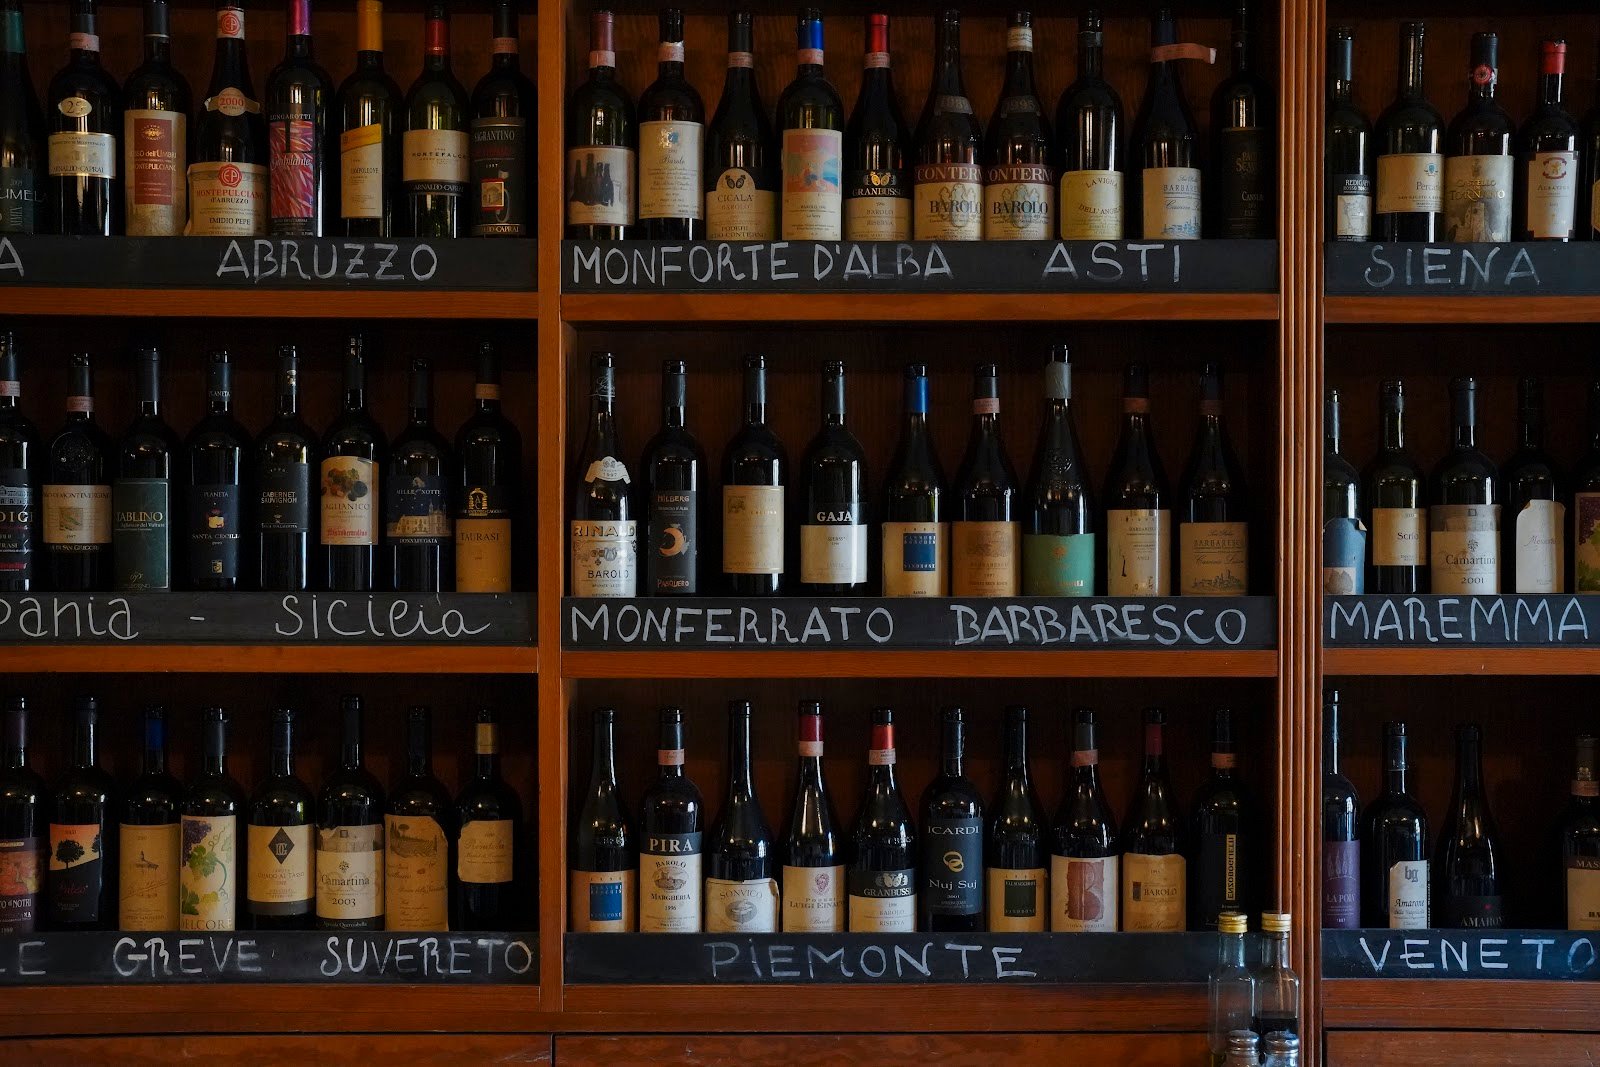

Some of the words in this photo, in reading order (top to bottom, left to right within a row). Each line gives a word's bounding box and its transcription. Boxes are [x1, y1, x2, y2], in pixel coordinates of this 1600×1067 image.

[220, 98, 244, 106] 2000
[930, 200, 982, 213] BAROLO
[993, 200, 1048, 214] BAROLO
[216, 239, 438, 284] ABRUZZO
[573, 243, 799, 286] MONFORTE
[813, 243, 954, 281] D'ALBA
[1042, 242, 1181, 283] ASTI
[1364, 245, 1541, 288] SIENA
[816, 511, 852, 522] GAJA
[1445, 554, 1496, 565] Camartina
[571, 604, 893, 643] MONFERRATO
[950, 604, 1247, 645] BARBARESCO
[1329, 598, 1589, 642] MAREMMA
[927, 825, 980, 835] ICARDI
[649, 838, 693, 852] PIRA
[655, 860, 687, 868] BAROLO
[321, 874, 370, 886] Camartina
[1404, 865, 1419, 883] bg
[928, 879, 953, 891] Nuj
[957, 879, 977, 889] Suj
[1143, 887, 1177, 896] BAROLO
[331, 897, 356, 906] 2003
[651, 893, 691, 901] MARGHERIA
[1394, 899, 1425, 908] Amarone
[790, 901, 815, 909] LUIGI
[113, 936, 262, 978] GREVE
[320, 936, 533, 977] SUVERETO
[703, 938, 1037, 979] PIEMONTE
[1359, 937, 1596, 974] VENETO
